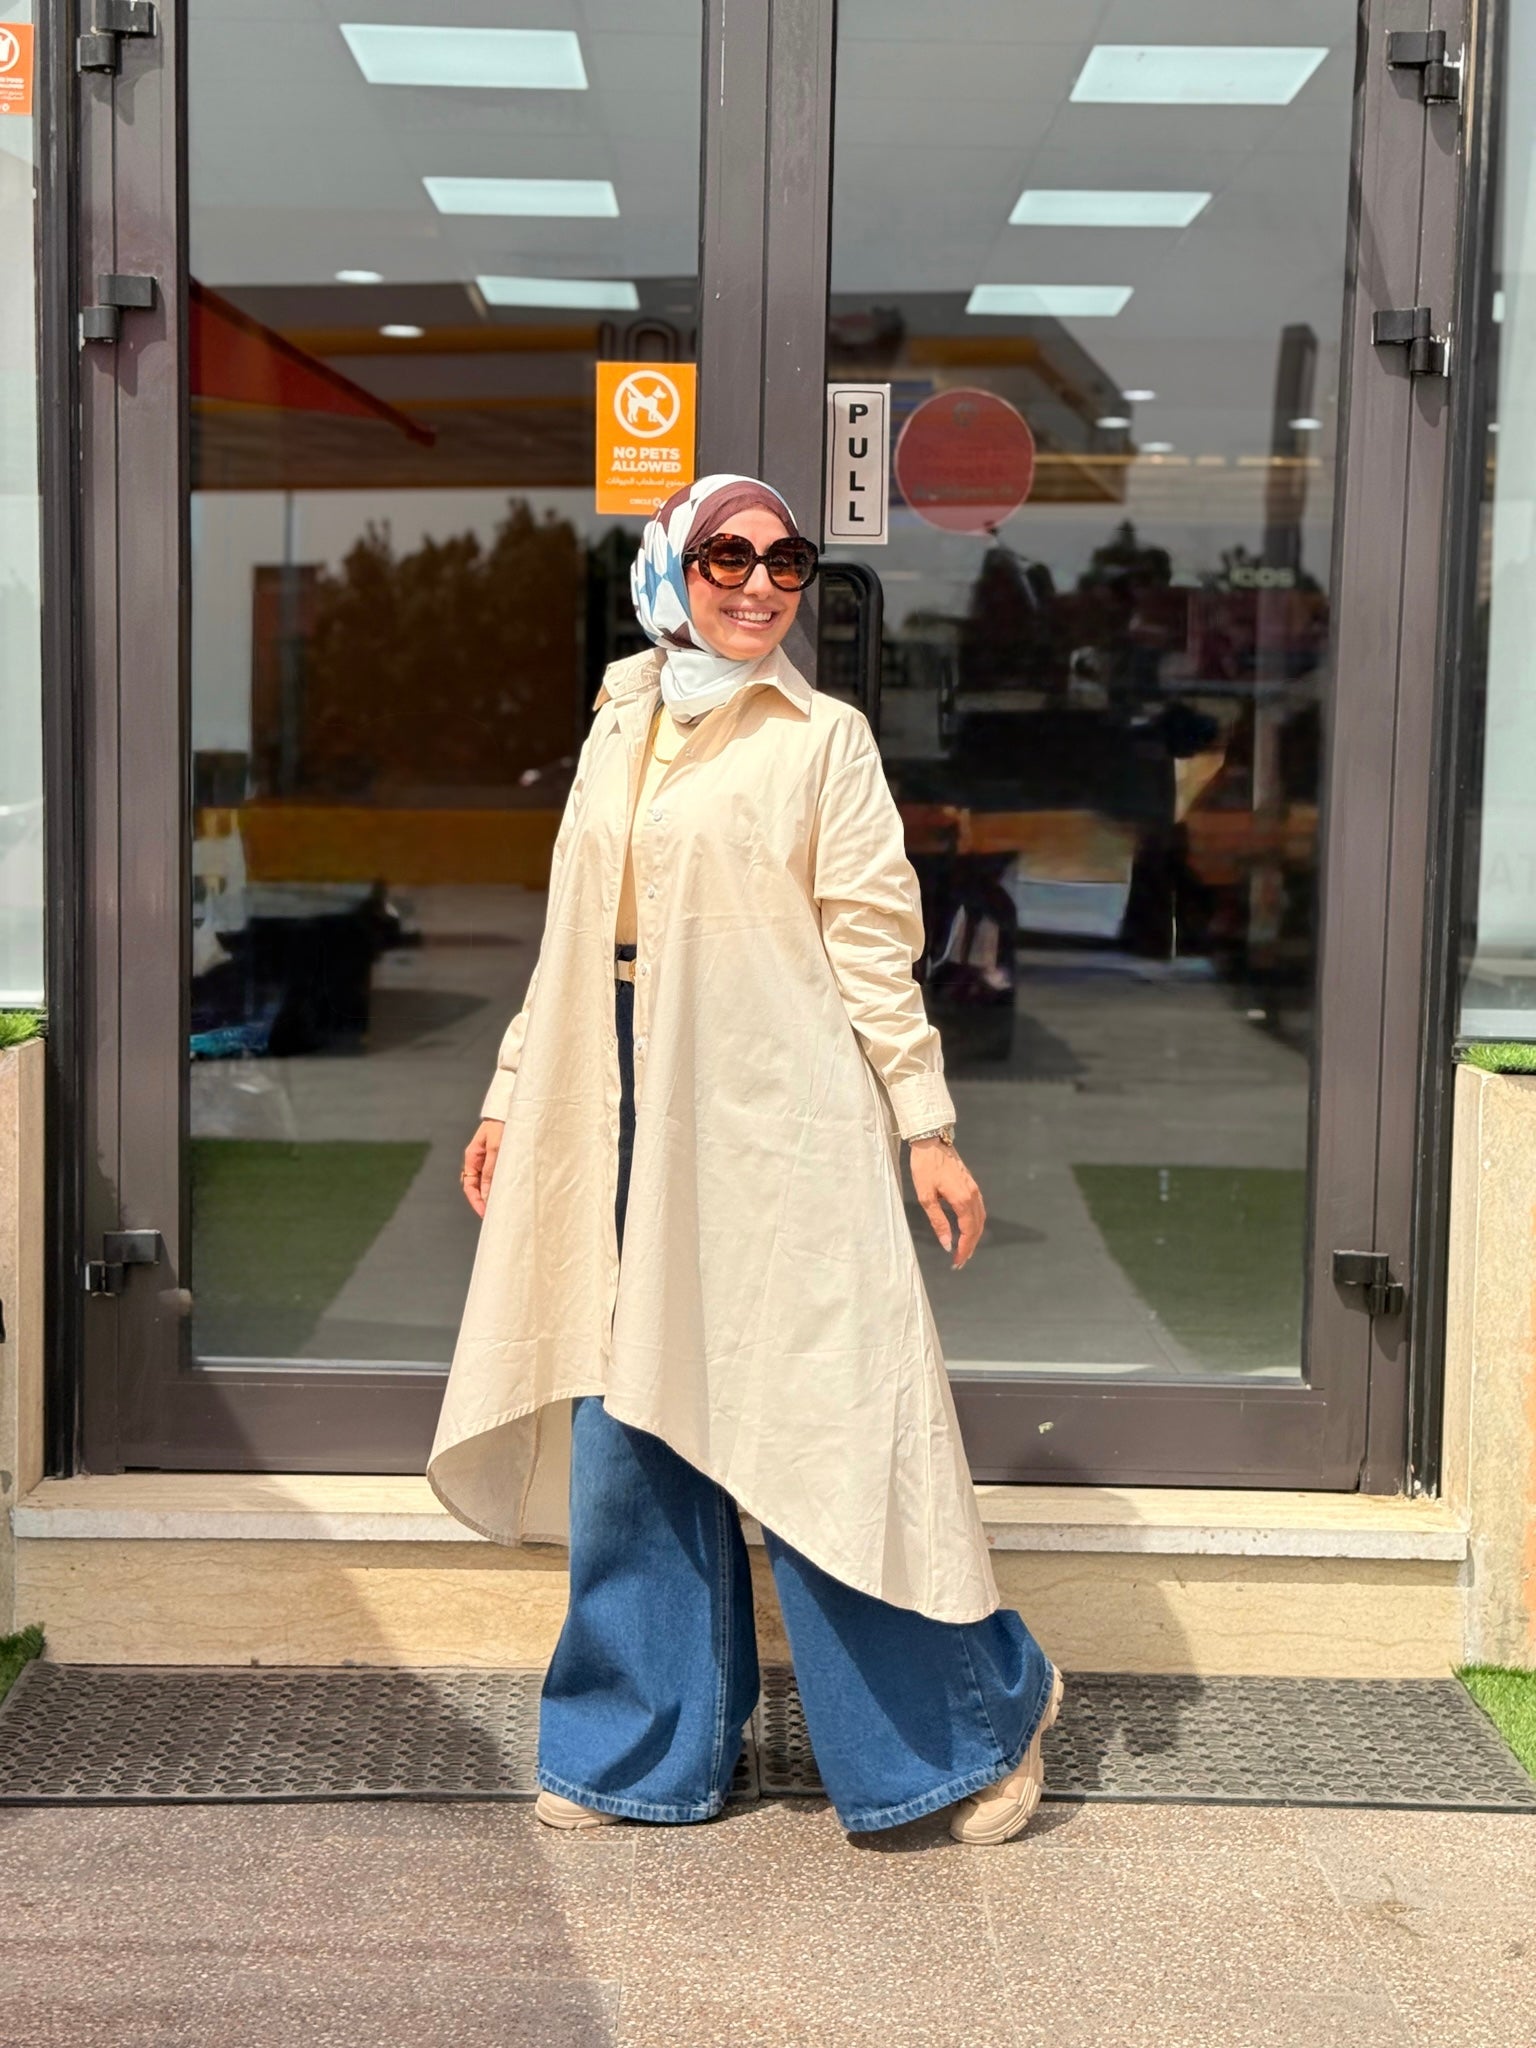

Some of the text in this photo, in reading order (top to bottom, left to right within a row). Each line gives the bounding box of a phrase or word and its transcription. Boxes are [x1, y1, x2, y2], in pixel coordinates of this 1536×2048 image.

[613, 446, 680, 461] NO PETS
[611, 460, 682, 474] ALLOWED
[848, 403, 869, 522] PULL
